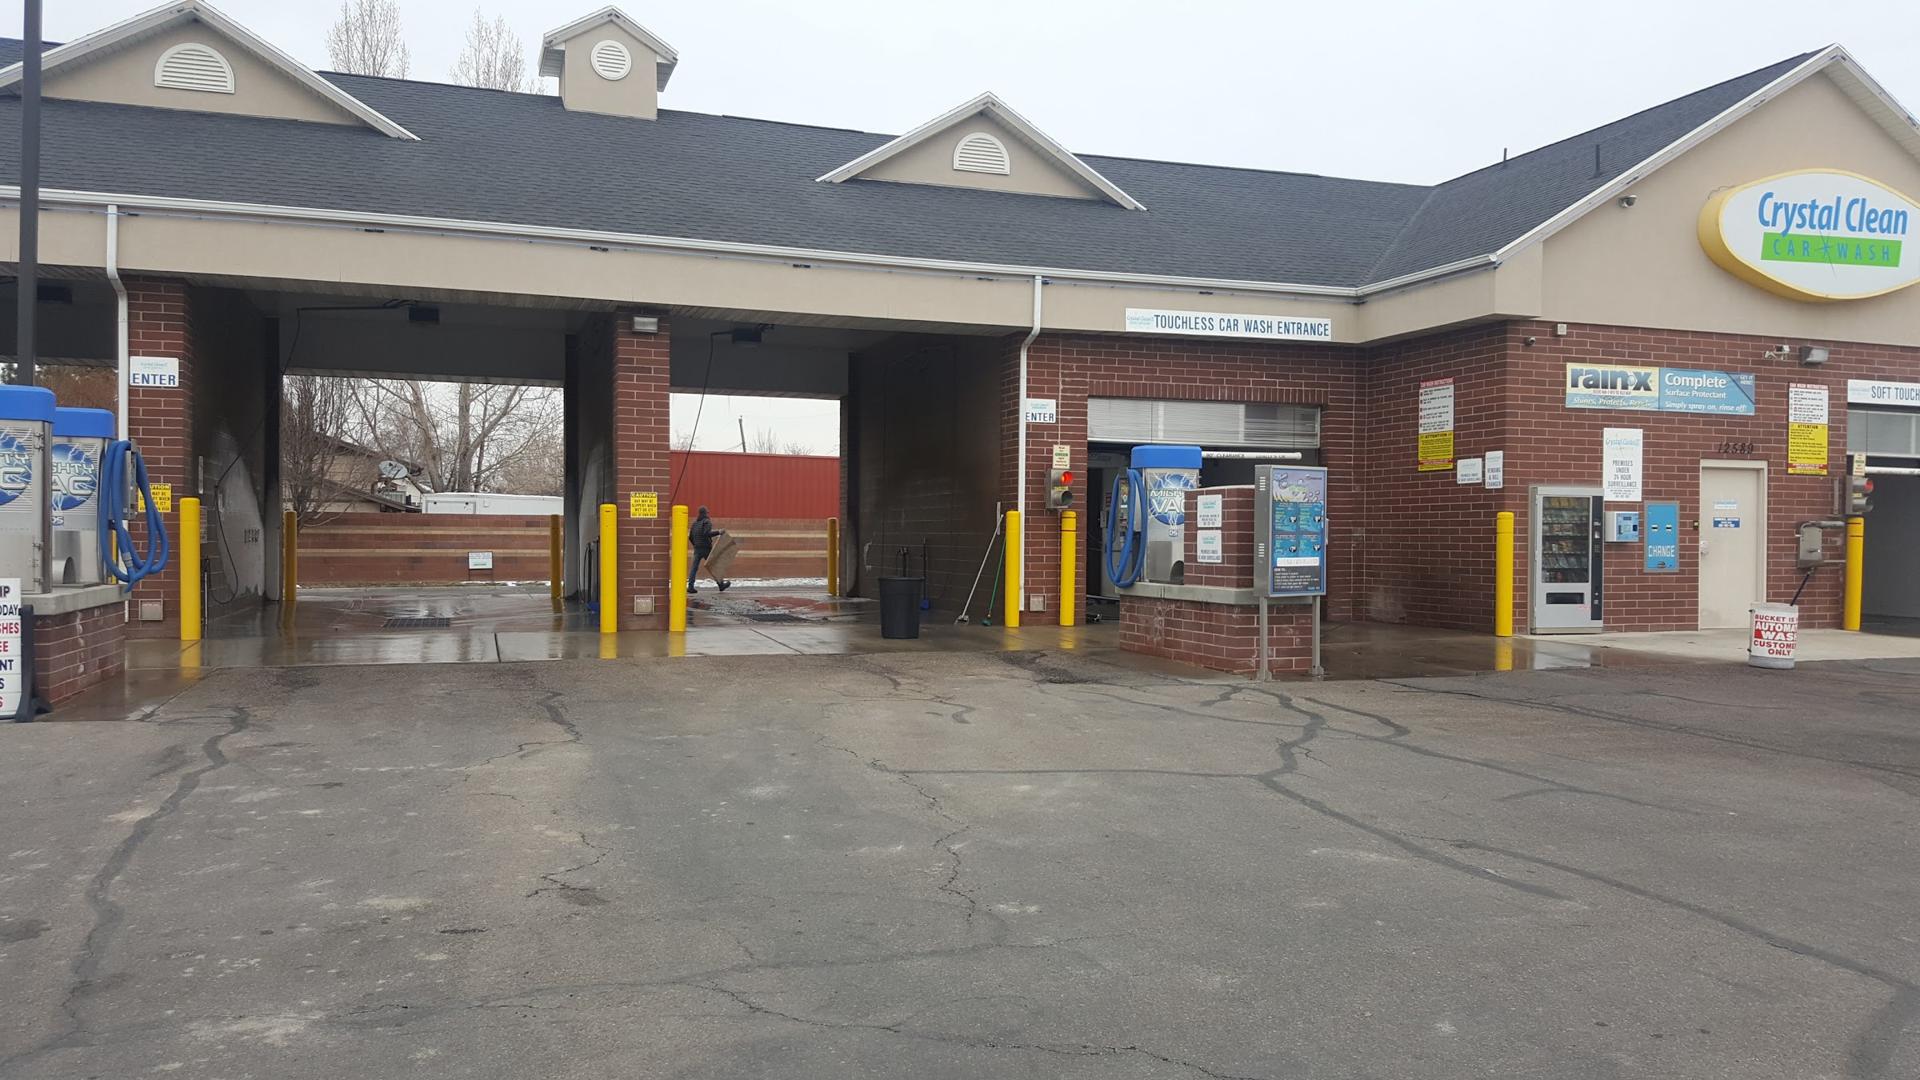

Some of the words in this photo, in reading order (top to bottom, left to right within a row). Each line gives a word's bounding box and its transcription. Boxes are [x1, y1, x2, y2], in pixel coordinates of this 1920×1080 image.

[1758, 191, 1842, 237] Crystal
[1846, 197, 1908, 235] Clean
[1772, 238, 1810, 257] CAR
[1836, 242, 1890, 261] WASH
[1154, 314, 1214, 331] TOUCHLESS
[1219, 318, 1239, 332] CAR
[1244, 319, 1273, 334] WASH
[1277, 321, 1329, 337] ENTRANCE
[132, 373, 176, 385] ENTER
[1664, 372, 1727, 389] Complete
[1692, 389, 1726, 399] Protectant
[1871, 386, 1892, 400] SOFT
[1894, 387, 1920, 401] TOUCH
[1026, 412, 1054, 422] ENTER
[1648, 545, 1675, 557] CHANGE
[1755, 614, 1786, 622] BUCKET
[1762, 630, 1796, 641] WAS
[1768, 648, 1792, 656] ONLY
